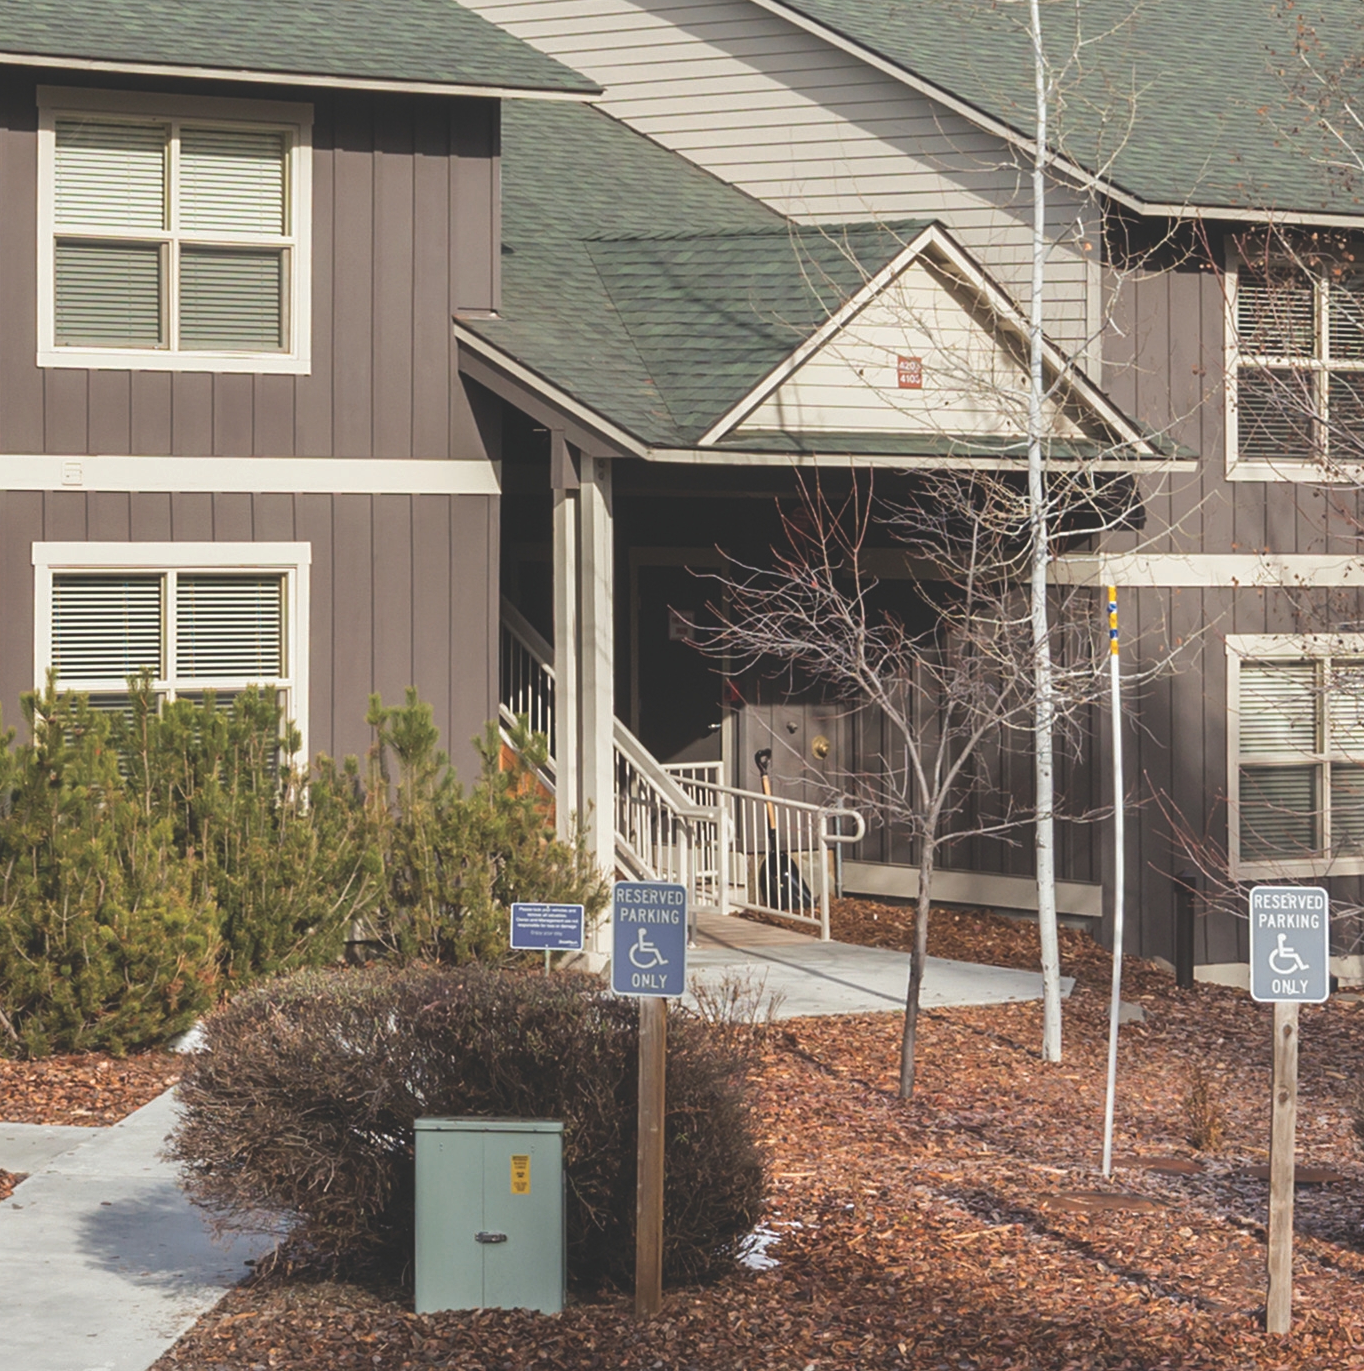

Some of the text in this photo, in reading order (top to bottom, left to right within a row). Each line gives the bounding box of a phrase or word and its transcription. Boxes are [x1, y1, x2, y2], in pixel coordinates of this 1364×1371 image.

[616, 888, 684, 905] RESERVED
[1254, 894, 1323, 910] RESERVED
[620, 907, 679, 924] PARKING
[1259, 914, 1320, 929] PARKING
[631, 972, 667, 989] ONLY
[1272, 979, 1308, 995] ONLY
